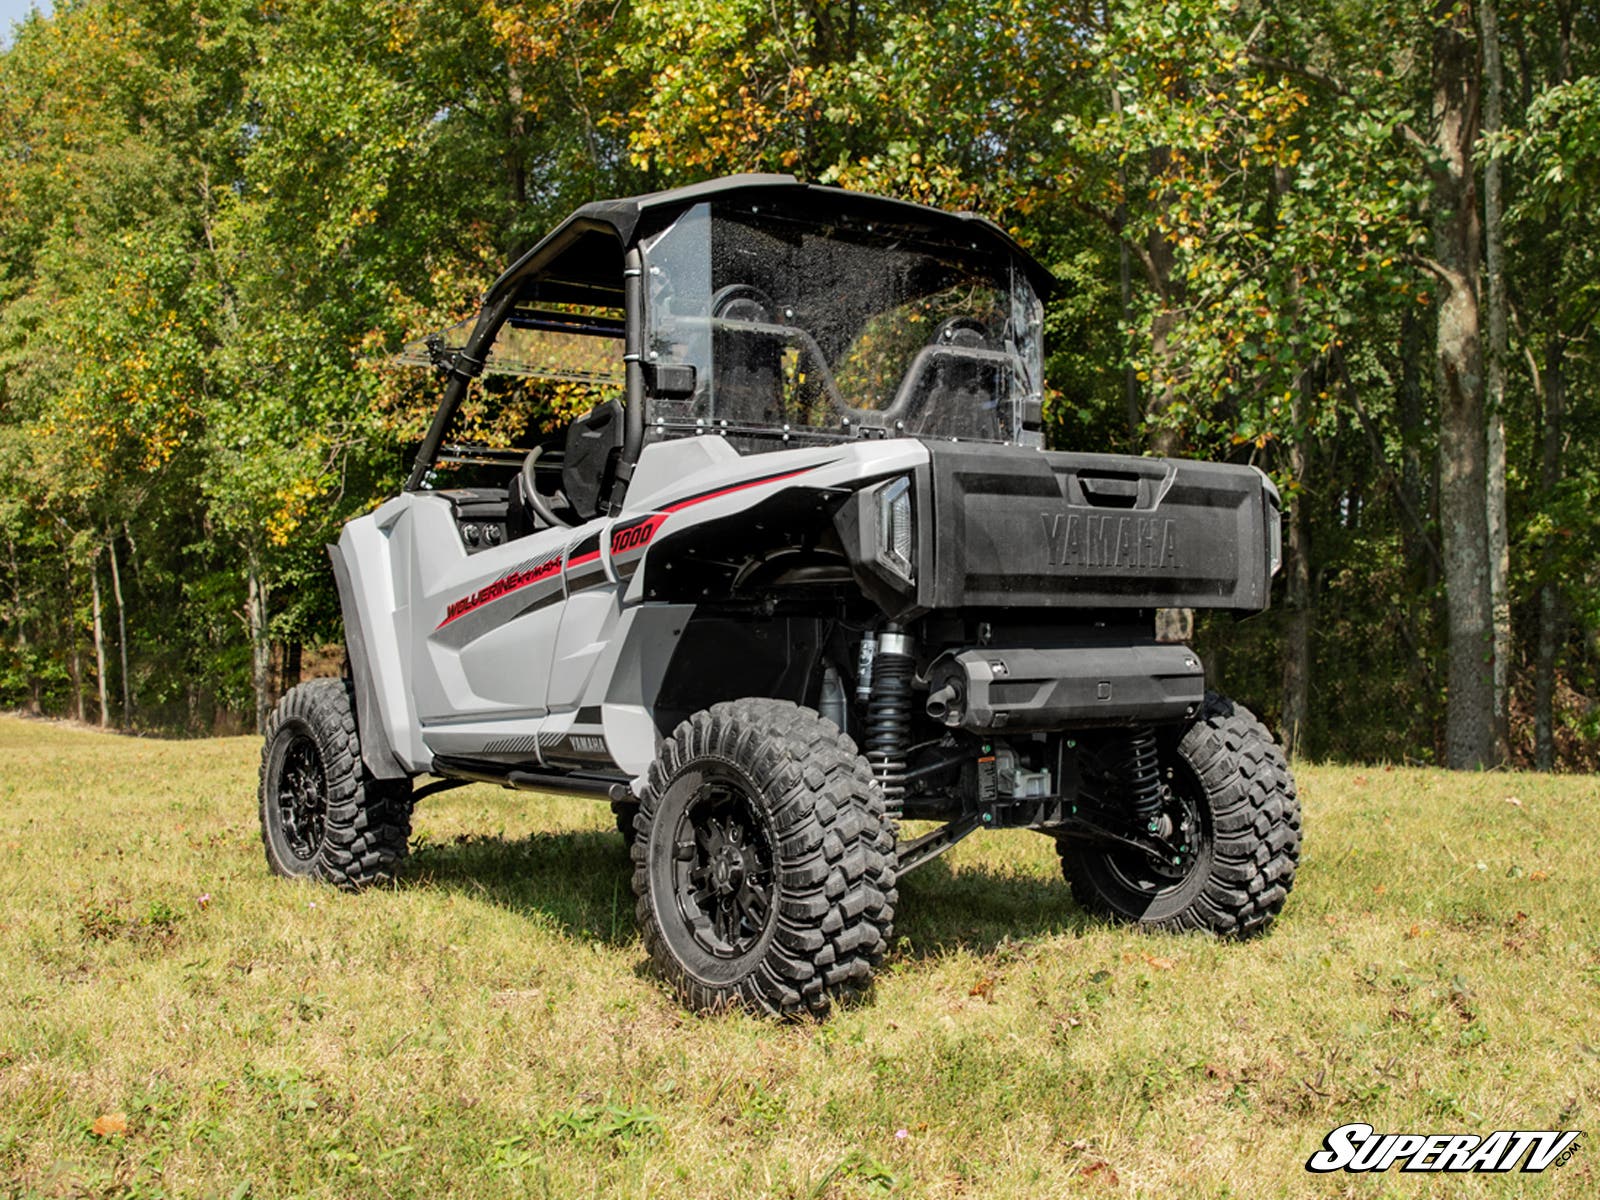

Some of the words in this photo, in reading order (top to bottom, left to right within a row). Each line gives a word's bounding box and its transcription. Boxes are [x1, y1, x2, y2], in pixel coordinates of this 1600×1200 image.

[613, 523, 653, 552] 1000
[1040, 512, 1181, 569] YAMAHA
[569, 735, 607, 753] YAMAHA
